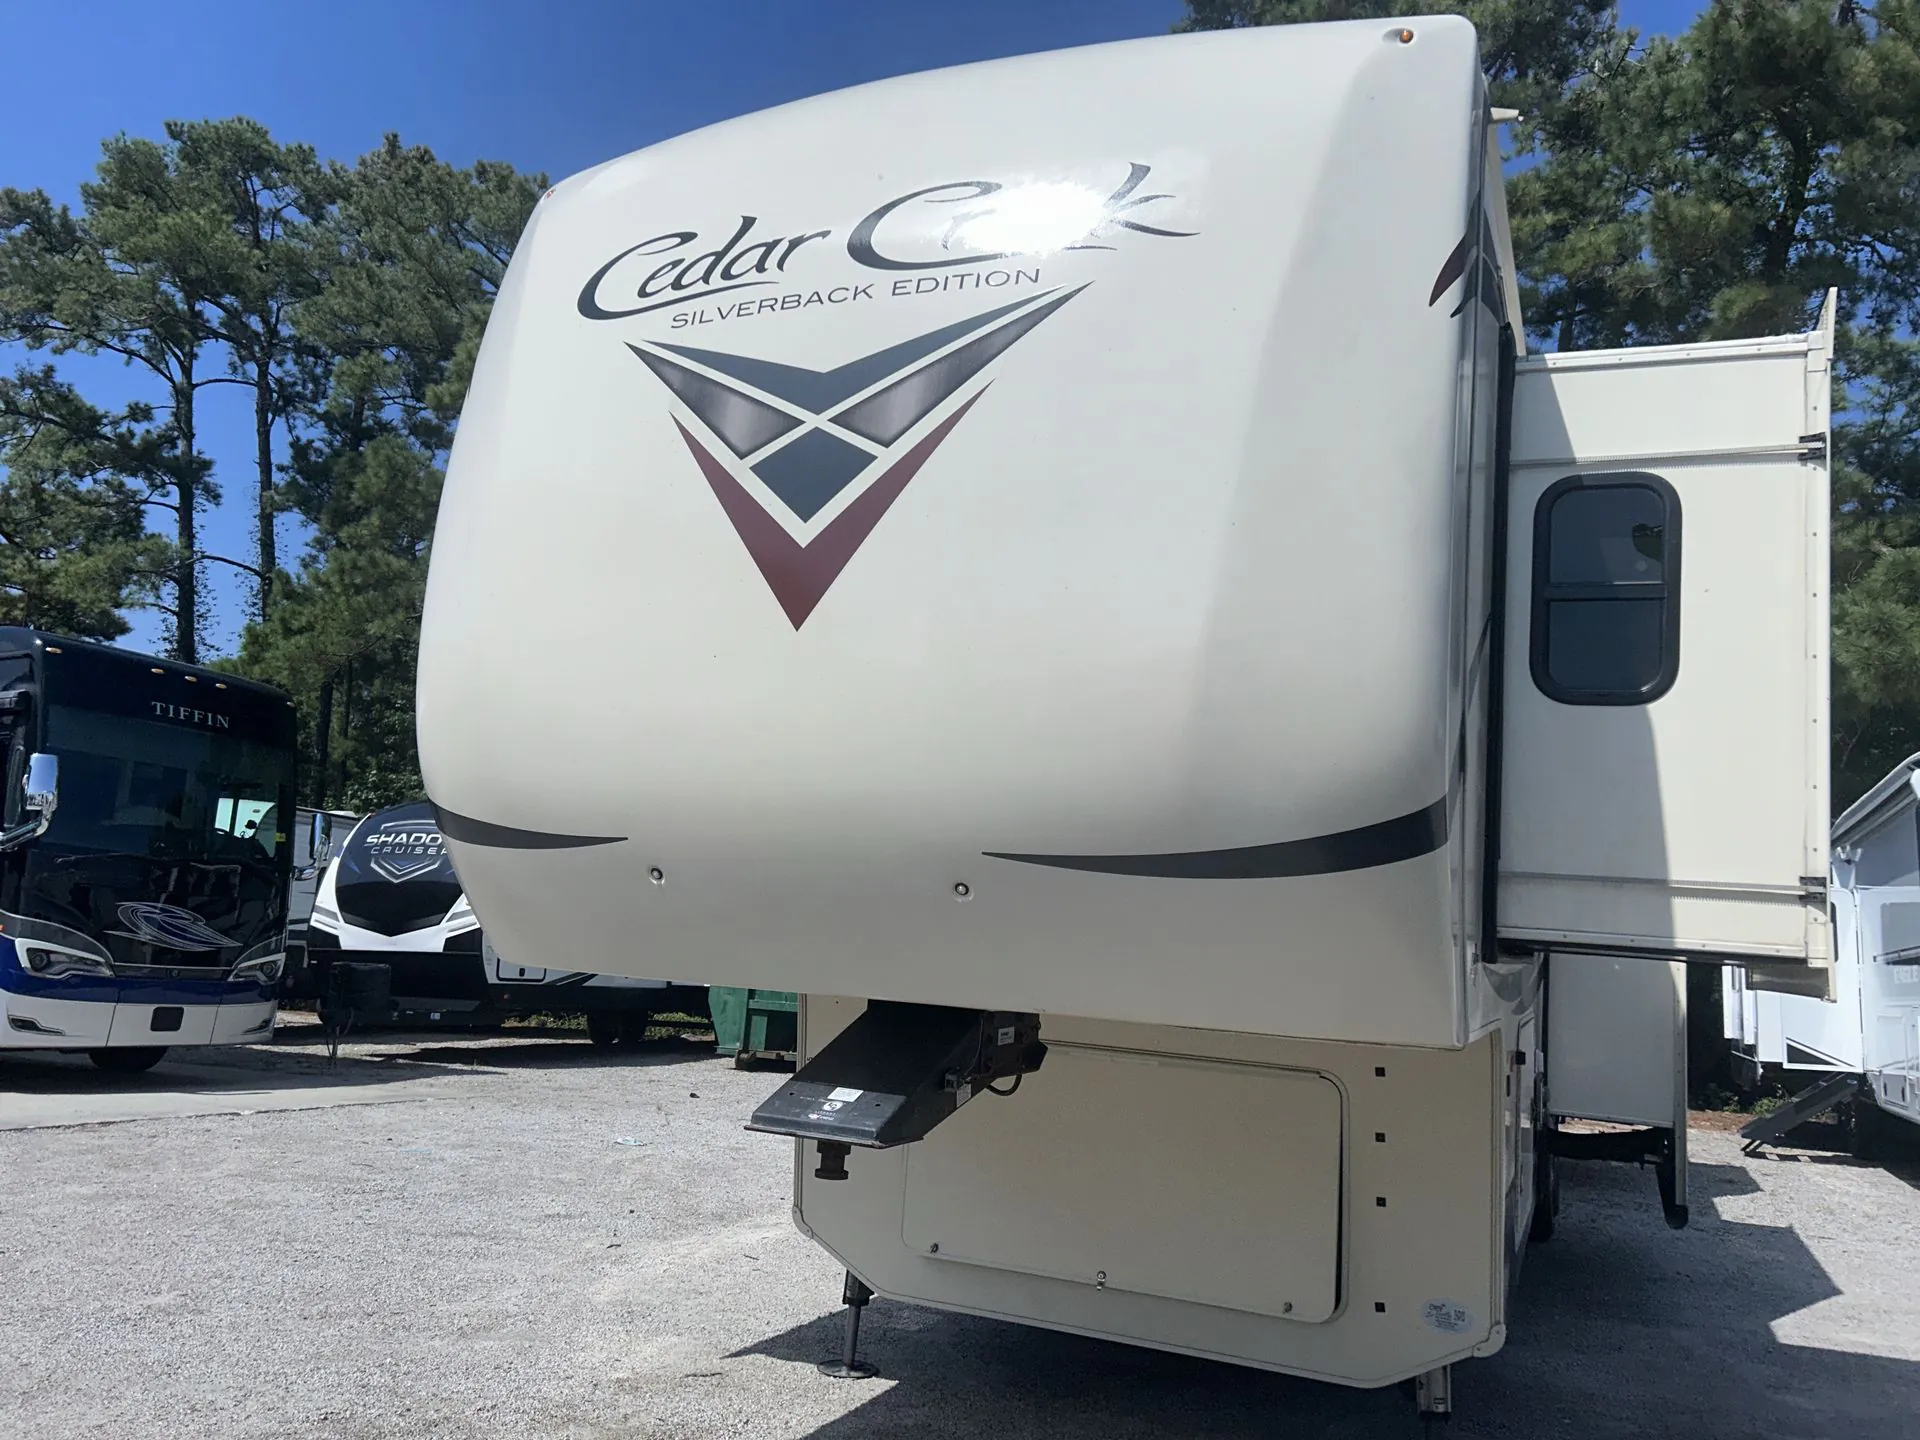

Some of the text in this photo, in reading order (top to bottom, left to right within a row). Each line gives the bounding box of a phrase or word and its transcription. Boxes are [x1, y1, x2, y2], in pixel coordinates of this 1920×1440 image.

[576, 161, 1201, 321] Cedar Crk
[670, 267, 1041, 329] SILVERBACK EDITION
[151, 701, 229, 729] TIFFIN
[363, 832, 443, 847] SHADO
